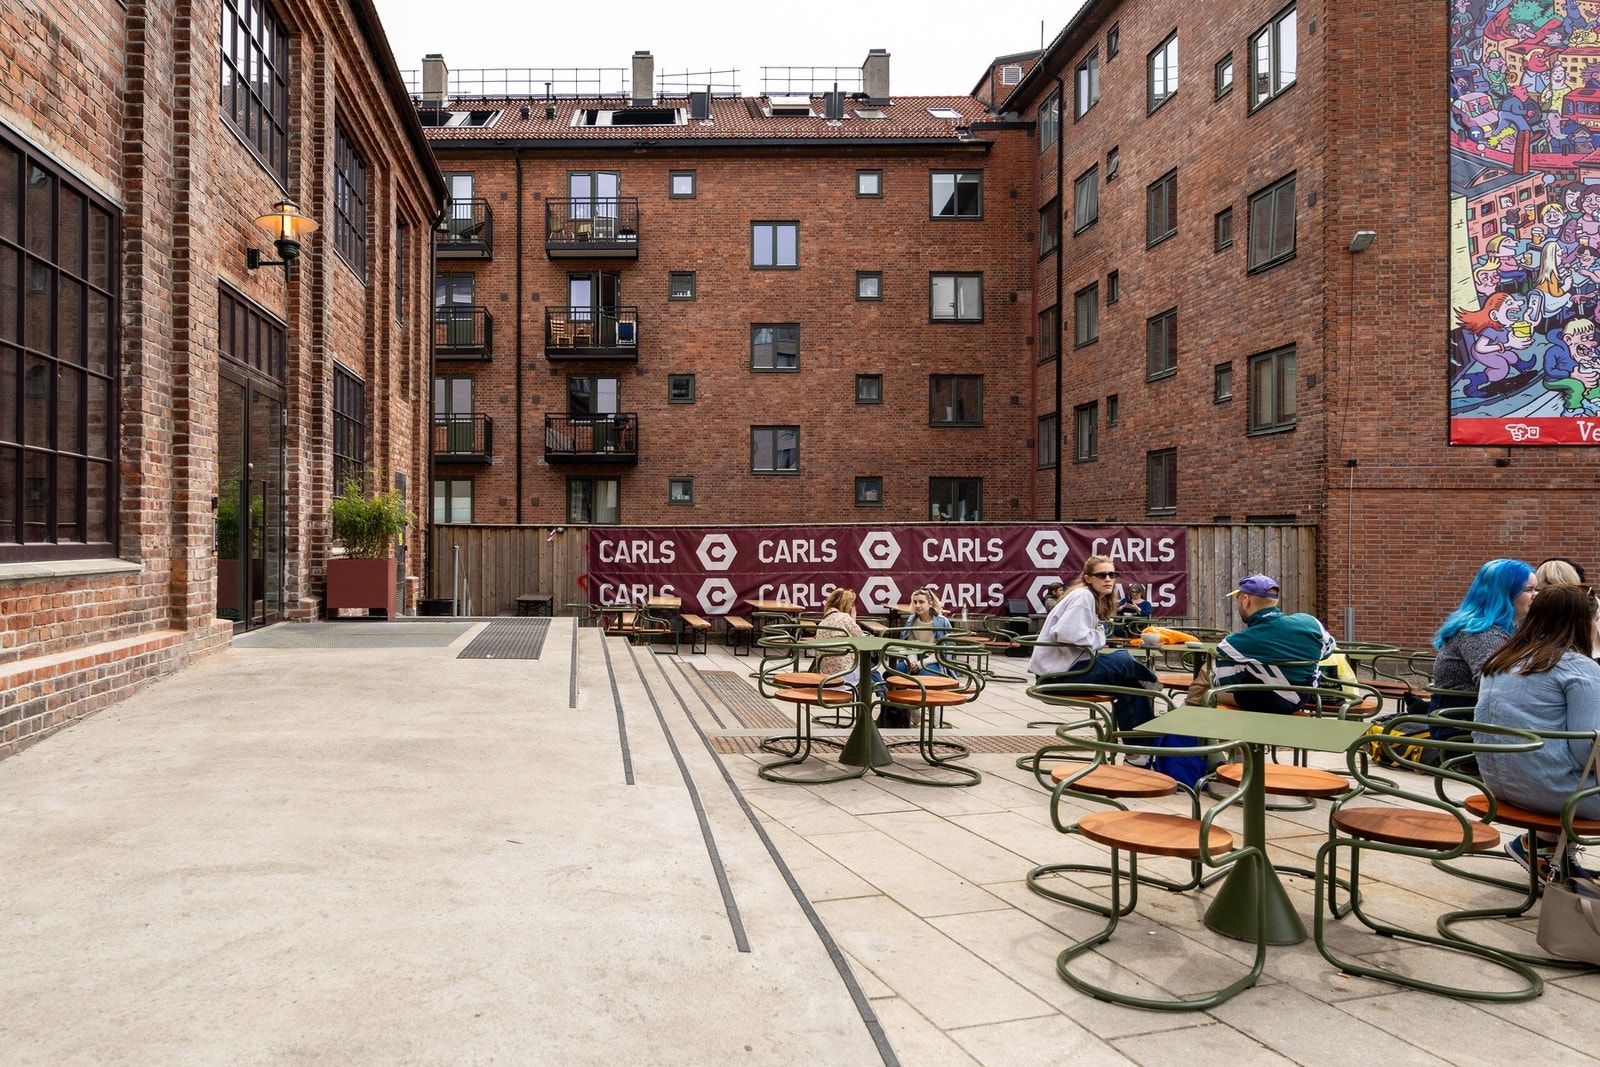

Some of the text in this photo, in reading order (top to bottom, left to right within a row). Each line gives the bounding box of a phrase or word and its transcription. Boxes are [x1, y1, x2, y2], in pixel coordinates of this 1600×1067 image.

[599, 540, 675, 563] CARLS
[759, 539, 837, 563] CARLS
[923, 538, 1003, 562] CARLS
[1092, 538, 1175, 562] CARLS
